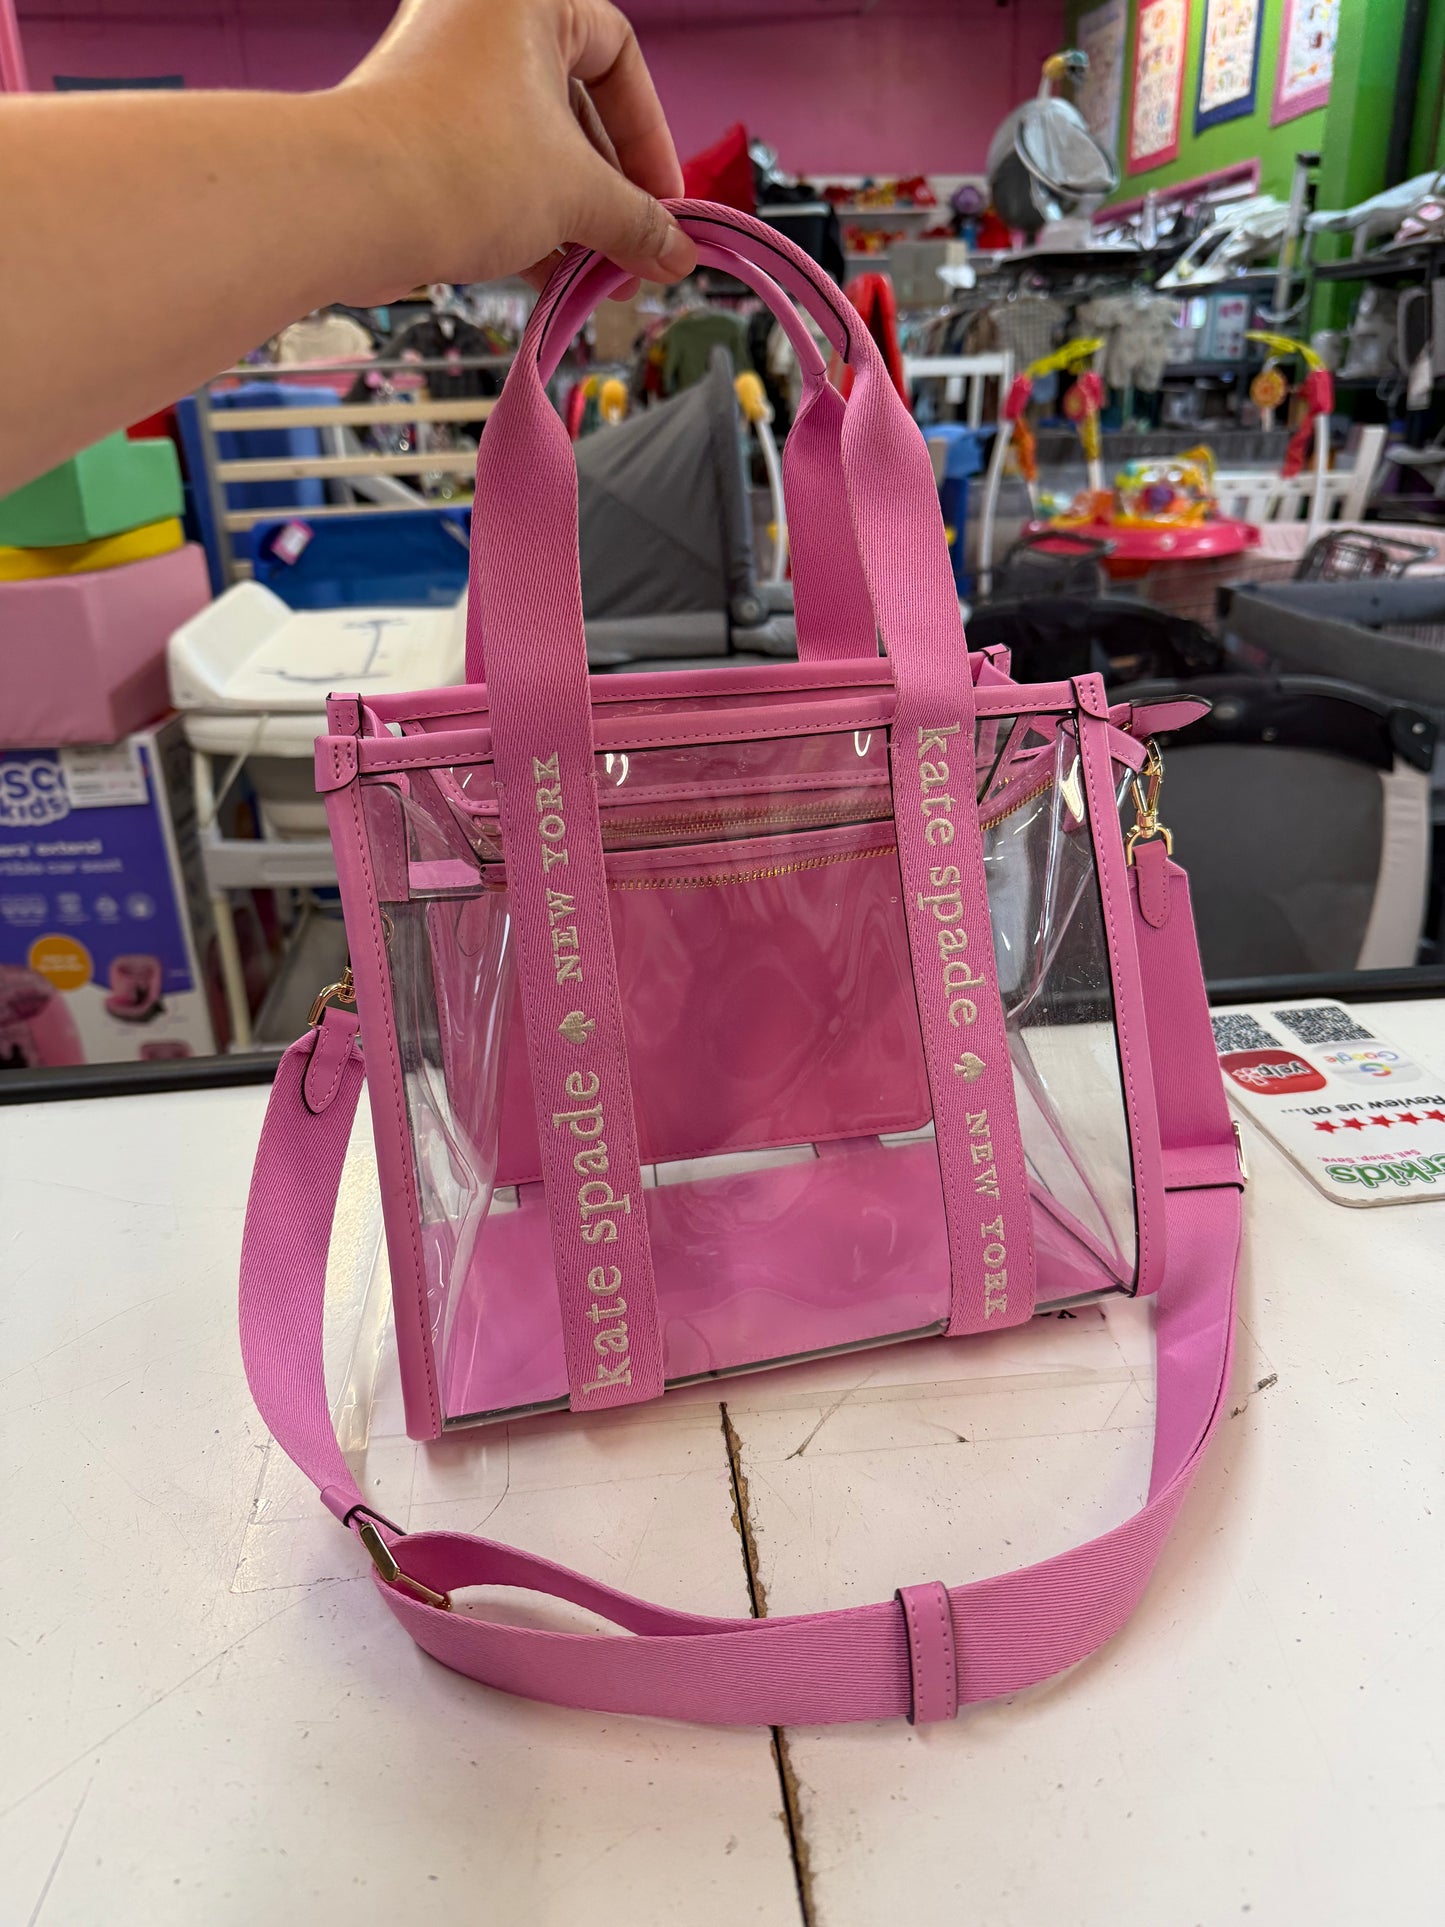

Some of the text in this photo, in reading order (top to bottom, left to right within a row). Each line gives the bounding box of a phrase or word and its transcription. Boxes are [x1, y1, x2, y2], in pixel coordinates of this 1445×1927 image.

[917, 722, 1007, 1320] kate spade NEW YORK
[1323, 1050, 1400, 1065] Google
[532, 751, 632, 1395] kate spade NEW YORK
[1257, 1061, 1310, 1078] yelp
[1335, 1103, 1364, 1112] us
[1369, 1094, 1445, 1110] Review
